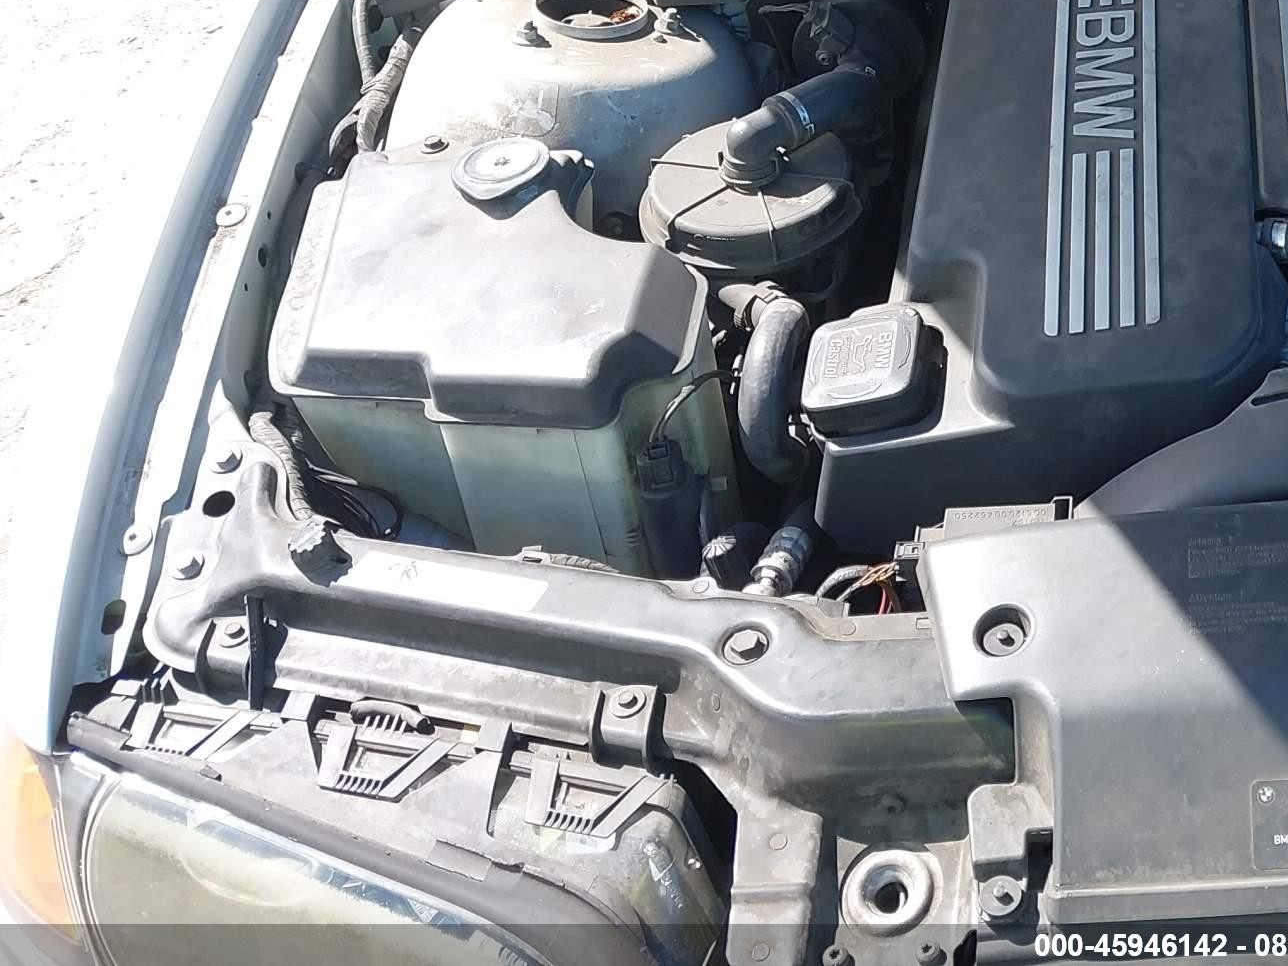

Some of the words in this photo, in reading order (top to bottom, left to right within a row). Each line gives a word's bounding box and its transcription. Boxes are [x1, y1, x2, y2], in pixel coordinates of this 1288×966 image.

[1072, 9, 1135, 139] BMW
[824, 339, 844, 378] Castrol
[874, 332, 893, 368] BMW
